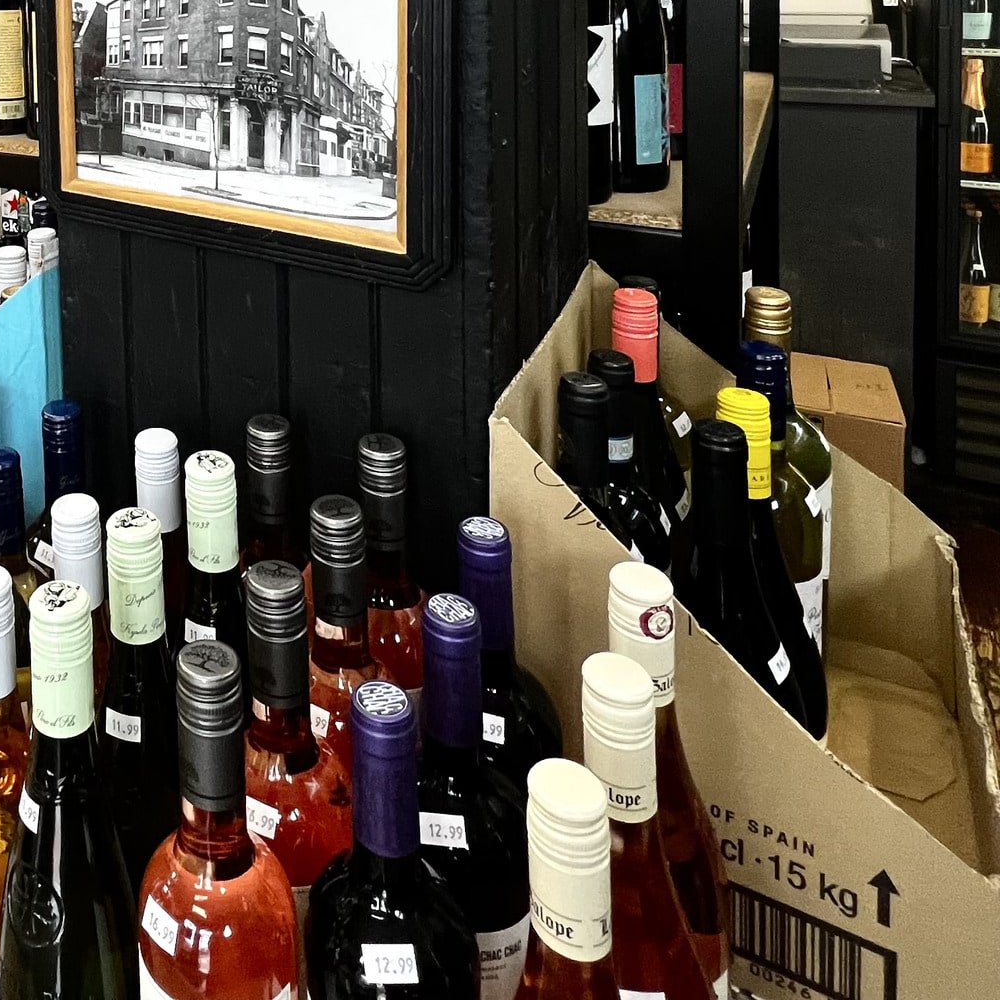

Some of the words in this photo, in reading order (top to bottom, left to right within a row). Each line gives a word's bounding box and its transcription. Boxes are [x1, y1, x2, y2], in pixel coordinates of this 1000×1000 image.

[44, 672, 68, 683] 1932
[112, 719, 139, 735] 11.99
[608, 786, 641, 811] lope
[428, 822, 463, 840] 12.99
[710, 804, 735, 822] OF
[748, 819, 815, 857] SPAIN
[720, 838, 744, 865] cl
[820, 872, 858, 918] kg
[148, 911, 176, 945] 16.99
[375, 955, 415, 976] 12.99
